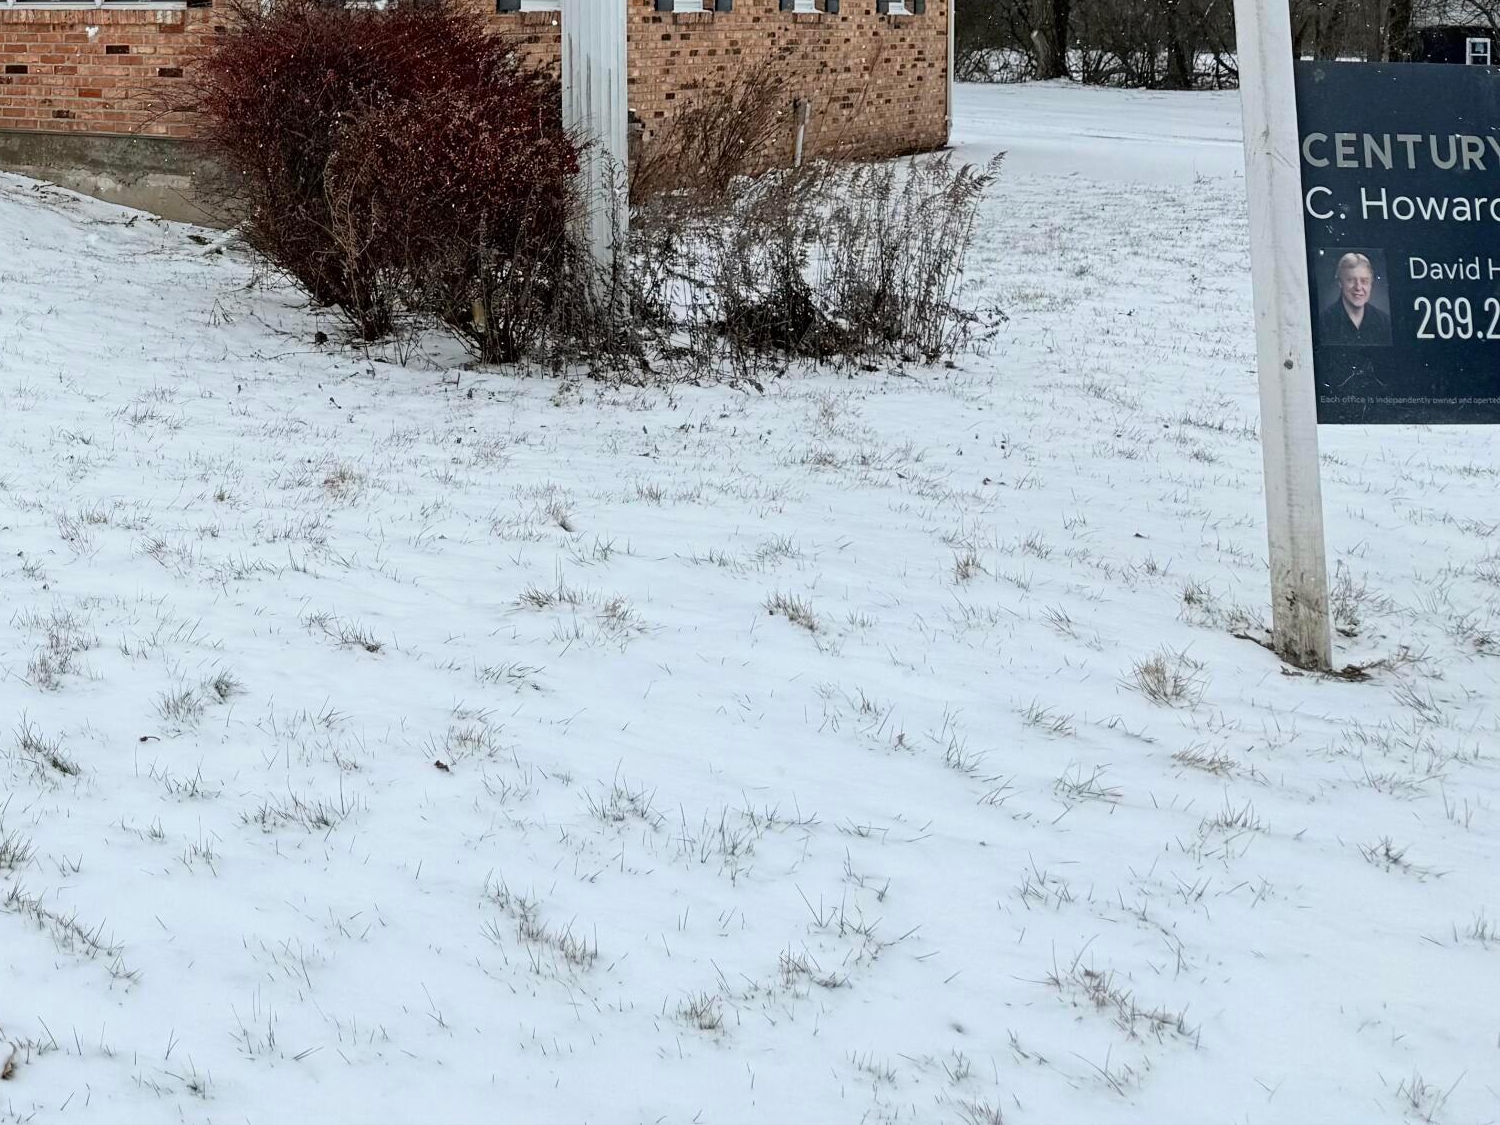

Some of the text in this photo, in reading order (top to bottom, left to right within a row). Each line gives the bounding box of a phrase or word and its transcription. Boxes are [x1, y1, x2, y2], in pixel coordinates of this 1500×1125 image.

[1305, 186, 1346, 220] C.
[1409, 256, 1480, 280] David
[1414, 296, 1500, 340] 269.2
[1320, 395, 1341, 404] Each
[1342, 395, 1366, 404] office
[1367, 395, 1375, 404] is
[1376, 395, 1431, 406] independently
[1433, 395, 1457, 404] owned
[1459, 395, 1472, 404] and
